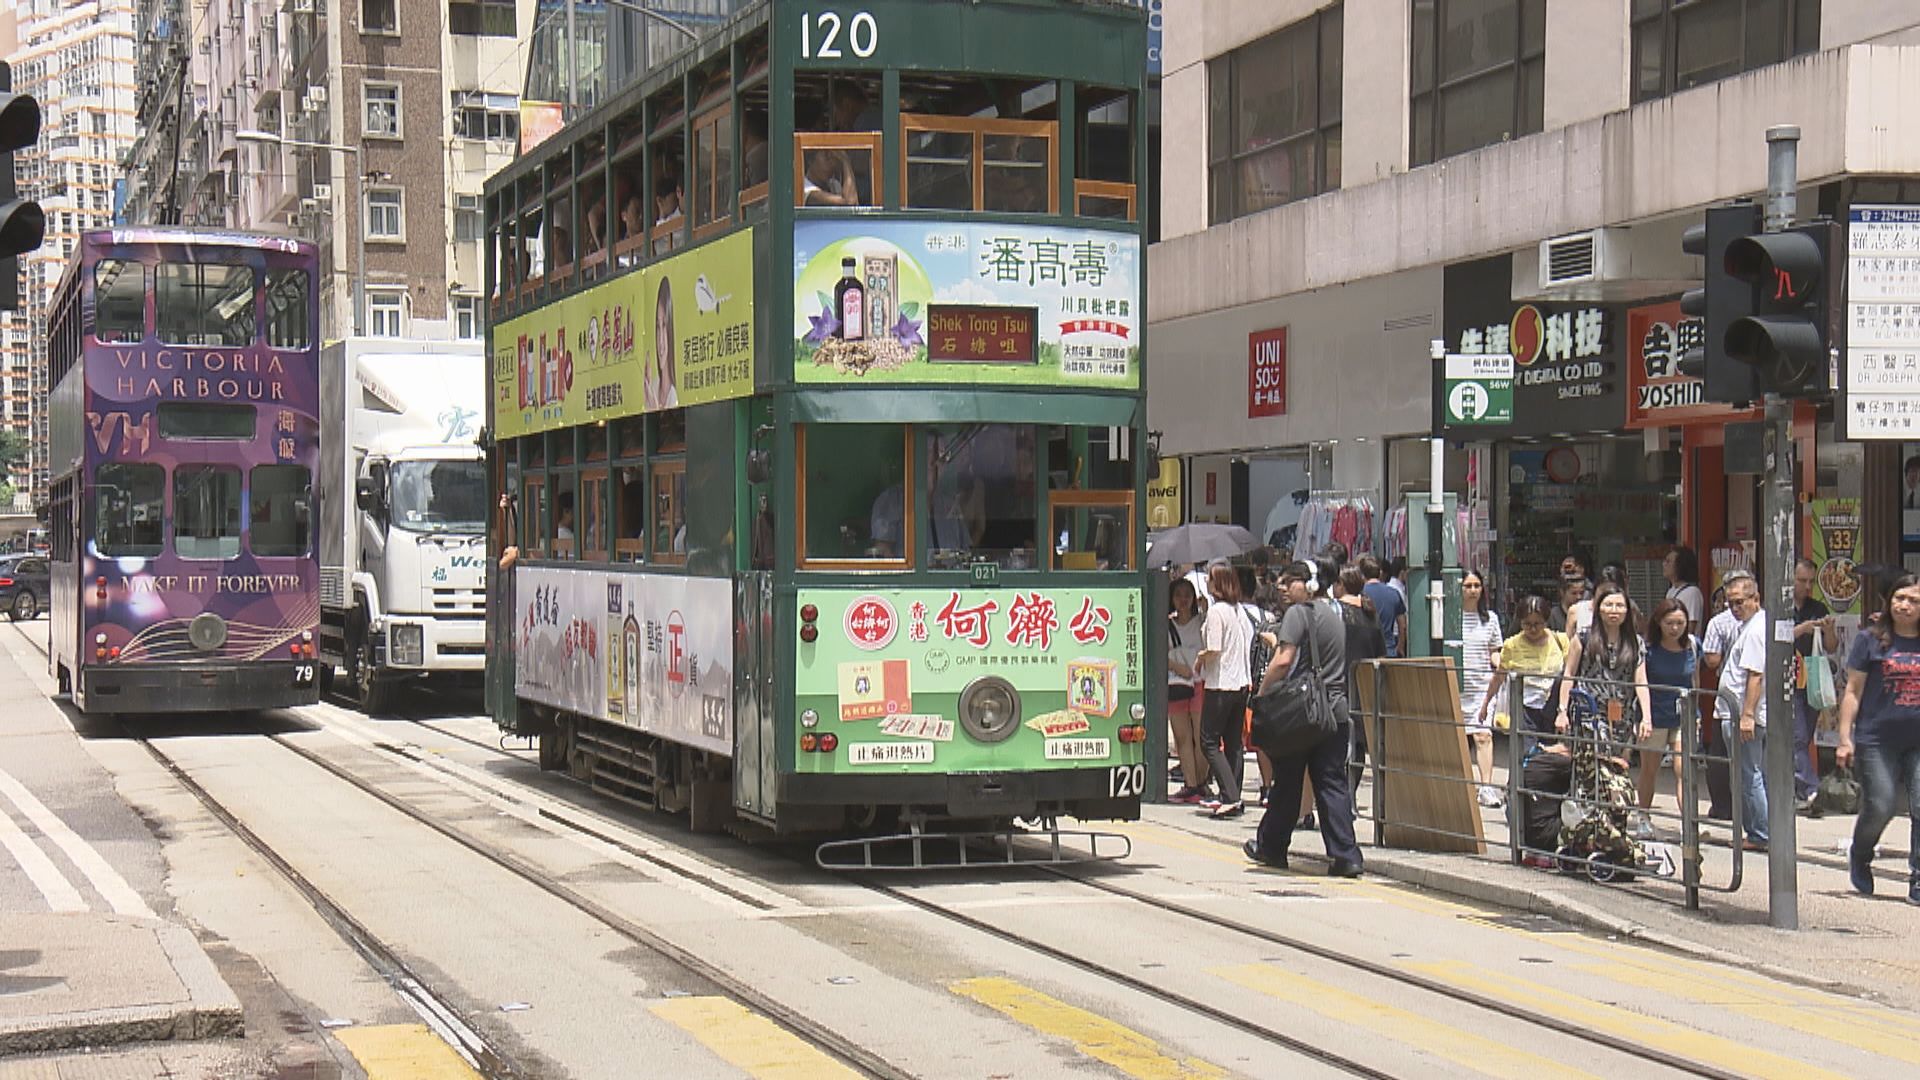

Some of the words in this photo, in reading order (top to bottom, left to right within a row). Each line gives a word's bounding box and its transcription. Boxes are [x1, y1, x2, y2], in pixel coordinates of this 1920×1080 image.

[800, 12, 880, 59] 120
[278, 240, 298, 253] 79
[1061, 296, 1129, 318] 川貝枇杷露
[930, 313, 962, 332] Shek
[968, 314, 998, 336] Tong
[1003, 316, 1028, 334] Tsui
[1546, 308, 1602, 361] 科技
[683, 331, 714, 367] 家居旅行
[717, 321, 749, 358] 必備良藥
[940, 337, 1018, 354] 石塘咀
[1255, 340, 1280, 366] UNI
[116, 350, 283, 373] VICTORIA
[1524, 366, 1563, 386] DIGITAL
[1563, 364, 1582, 381] CO
[1583, 361, 1603, 378] LTD
[1876, 373, 1913, 383] JOSEPH
[118, 377, 284, 399] HARBOUR
[1489, 380, 1510, 390] 56W
[121, 575, 178, 593] MAKE
[188, 576, 207, 593] IT
[216, 577, 300, 593] FOREVER
[975, 567, 996, 579] 021
[908, 600, 929, 641] 香港
[935, 592, 1112, 650] 何濟公
[956, 656, 976, 665] GMP
[295, 666, 313, 681] 79
[857, 746, 926, 761] 止痛退熱片
[1051, 742, 1105, 756] 止痛退熱散
[1109, 764, 1145, 798] 120
